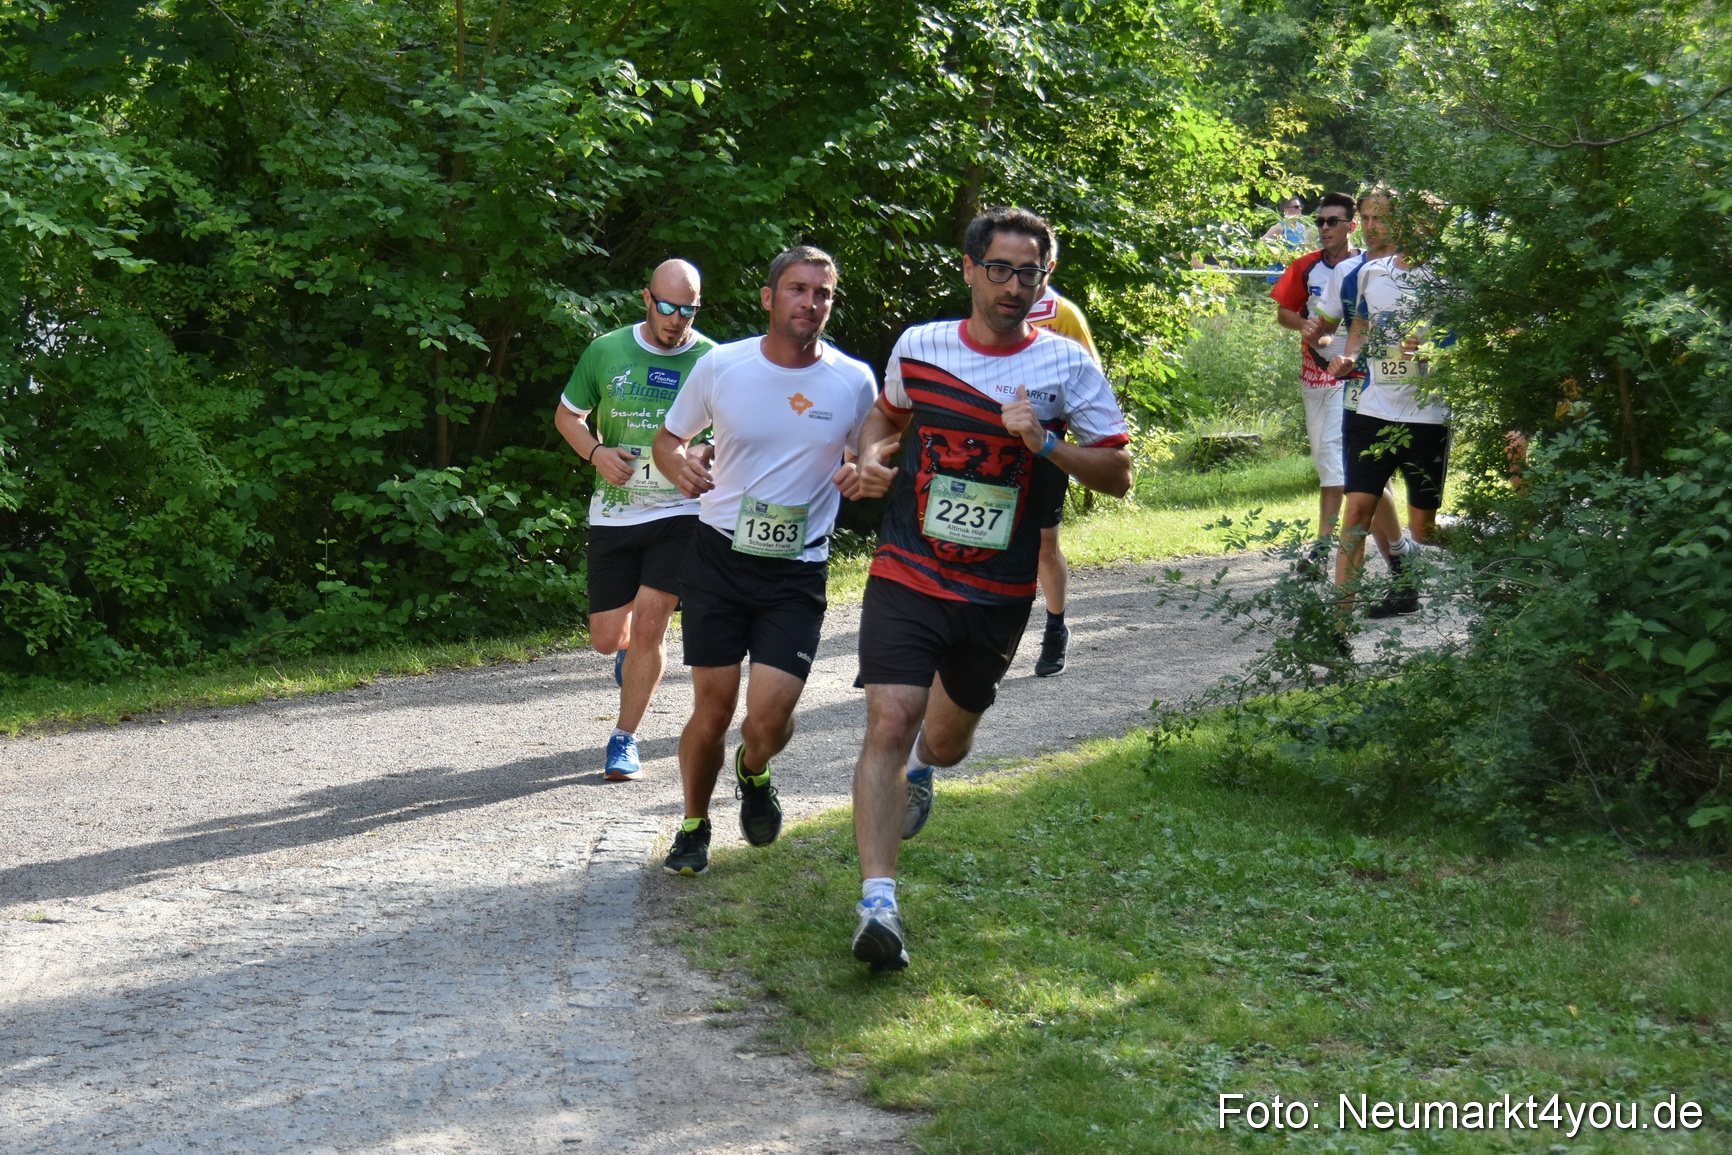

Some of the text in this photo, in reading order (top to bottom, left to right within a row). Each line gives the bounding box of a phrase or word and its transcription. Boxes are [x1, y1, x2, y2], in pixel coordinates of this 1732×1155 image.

[1381, 361, 1408, 375] 825
[654, 375, 678, 384] Fischer
[995, 385, 1048, 401] NEUARKT
[611, 407, 652, 418] Gesunde
[642, 464, 650, 480] 1
[935, 499, 1004, 530] 2237
[746, 519, 798, 543] 1363
[946, 524, 987, 536] Altinok Hidir
[748, 539, 775, 549] Schuster
